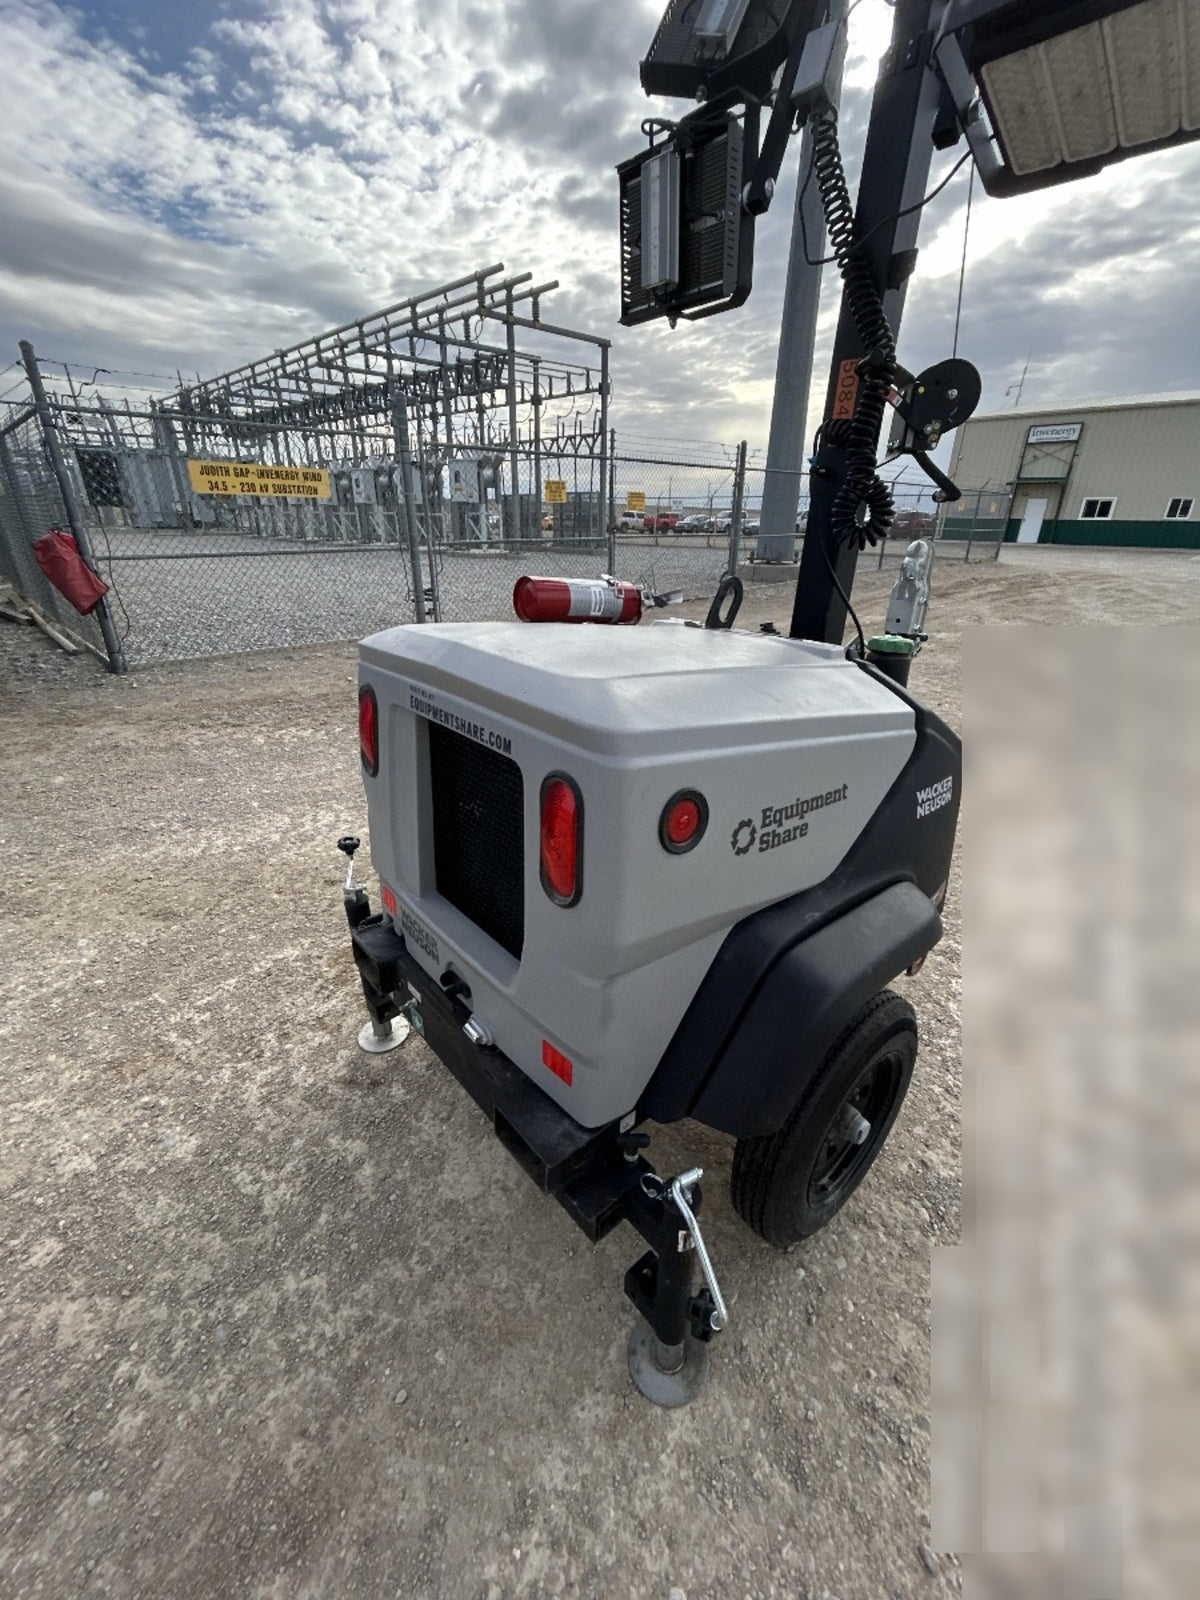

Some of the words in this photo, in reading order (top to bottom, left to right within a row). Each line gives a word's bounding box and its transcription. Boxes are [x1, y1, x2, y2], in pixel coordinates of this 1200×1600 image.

[837, 361, 857, 416] 5084
[199, 464, 231, 477] JUDITH
[302, 471, 322, 483] WIND
[207, 480, 229, 492] 34.5
[239, 482, 257, 493] 230
[272, 484, 319, 496] SUBSTATION
[409, 695, 512, 755] EQUIPMENTSHARE.COM
[916, 775, 953, 804] WACKER
[916, 789, 953, 819] NEUSON
[760, 783, 849, 829] Equipment
[758, 822, 809, 852] Share
